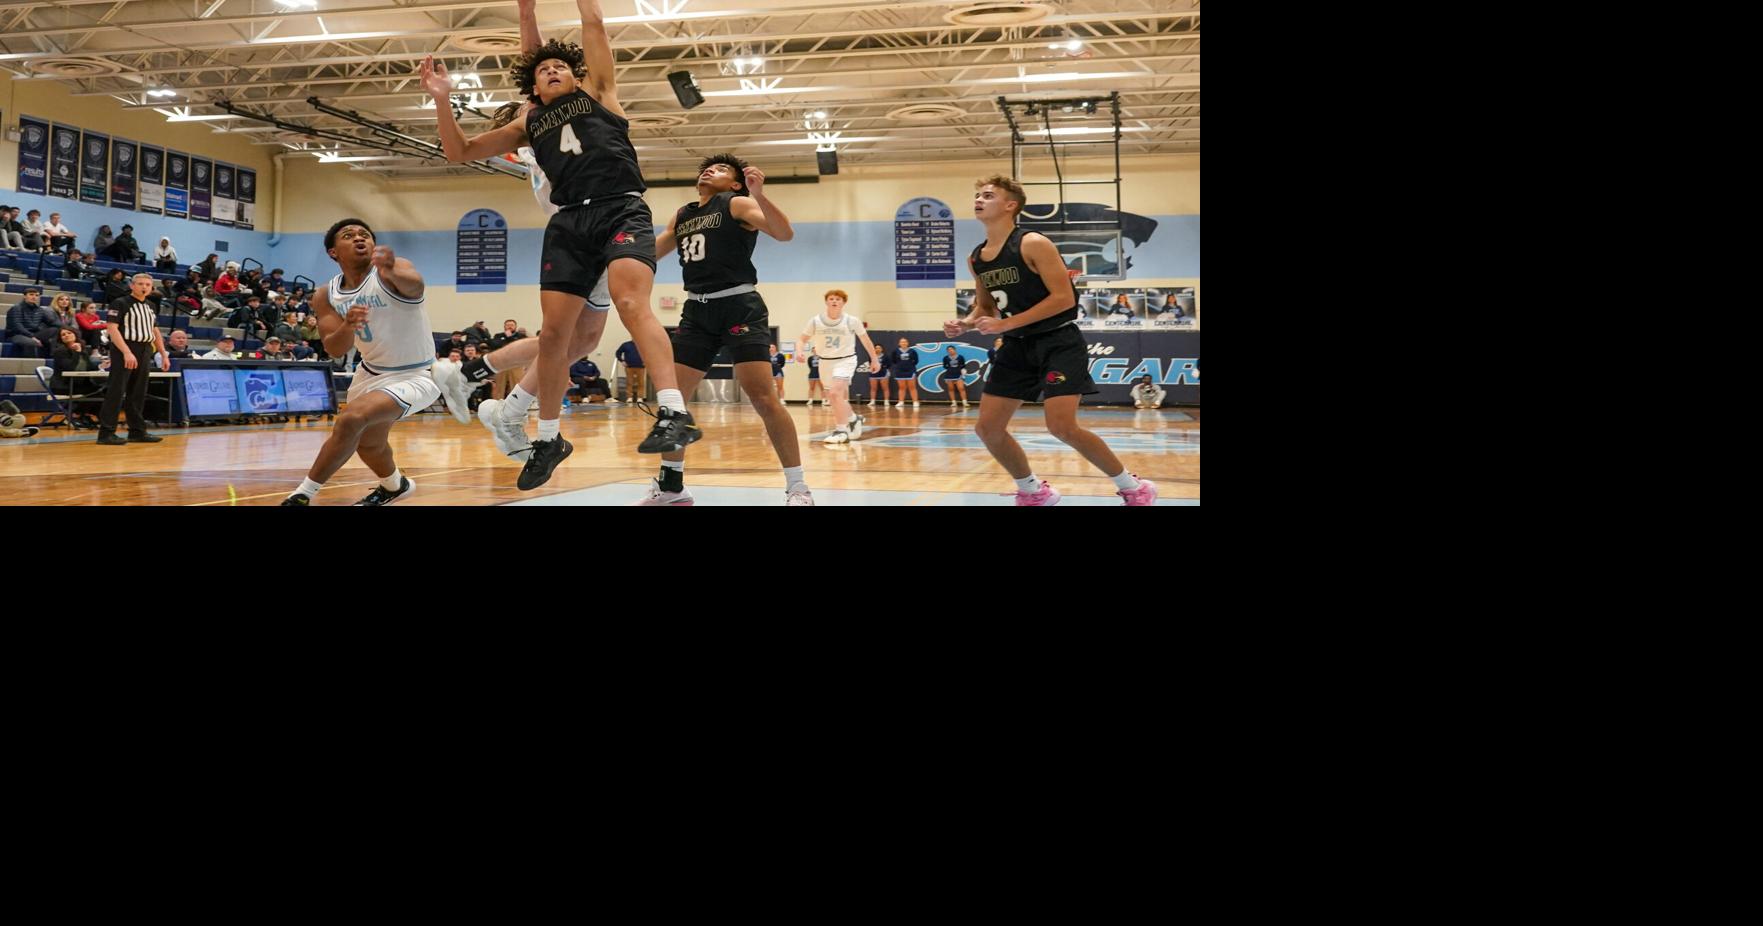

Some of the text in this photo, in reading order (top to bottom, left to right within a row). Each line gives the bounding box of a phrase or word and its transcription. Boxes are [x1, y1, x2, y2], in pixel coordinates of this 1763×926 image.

[560, 123, 583, 156] 4
[681, 233, 705, 262] 10
[824, 336, 840, 349] 24
